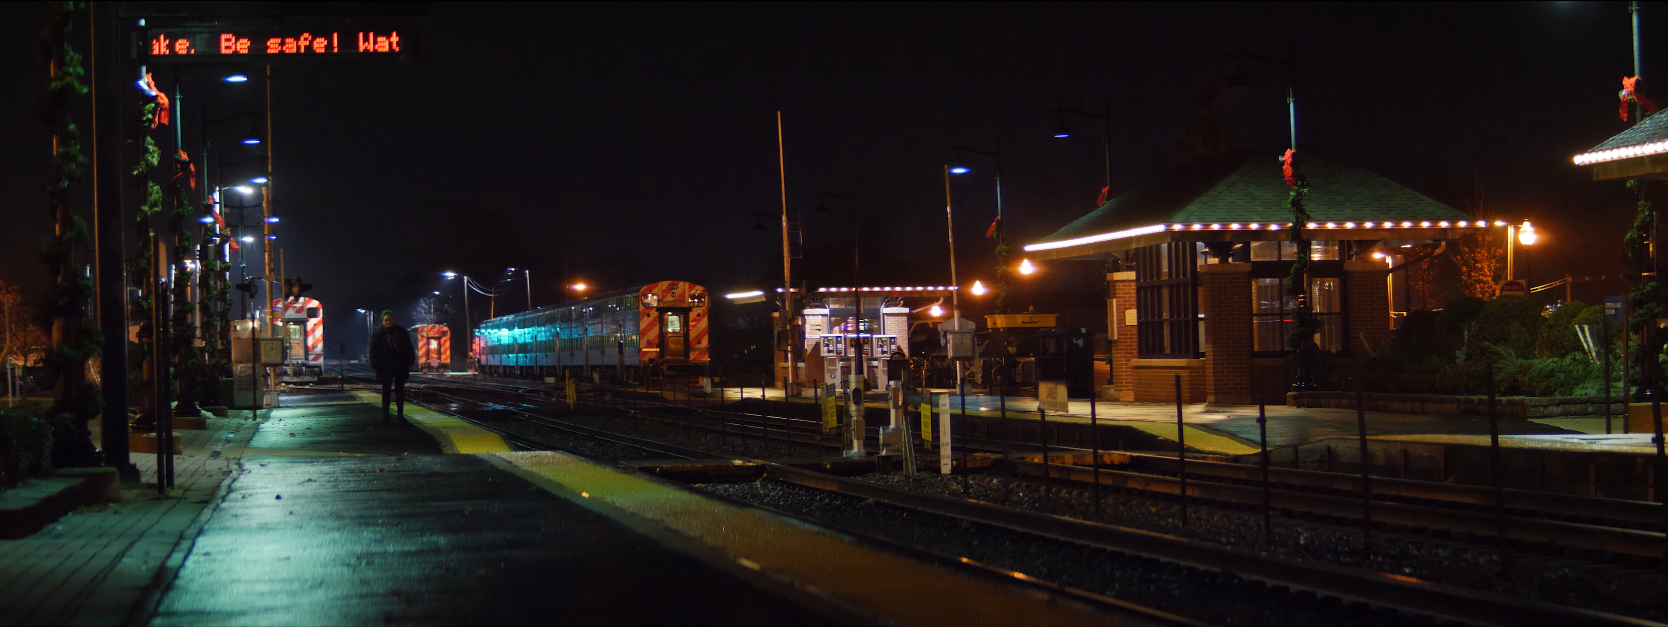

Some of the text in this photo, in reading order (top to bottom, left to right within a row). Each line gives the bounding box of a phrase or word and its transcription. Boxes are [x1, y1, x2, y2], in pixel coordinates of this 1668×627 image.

[219, 33, 251, 55] Be
[265, 32, 339, 54] safe!
[357, 30, 400, 53] Wat
